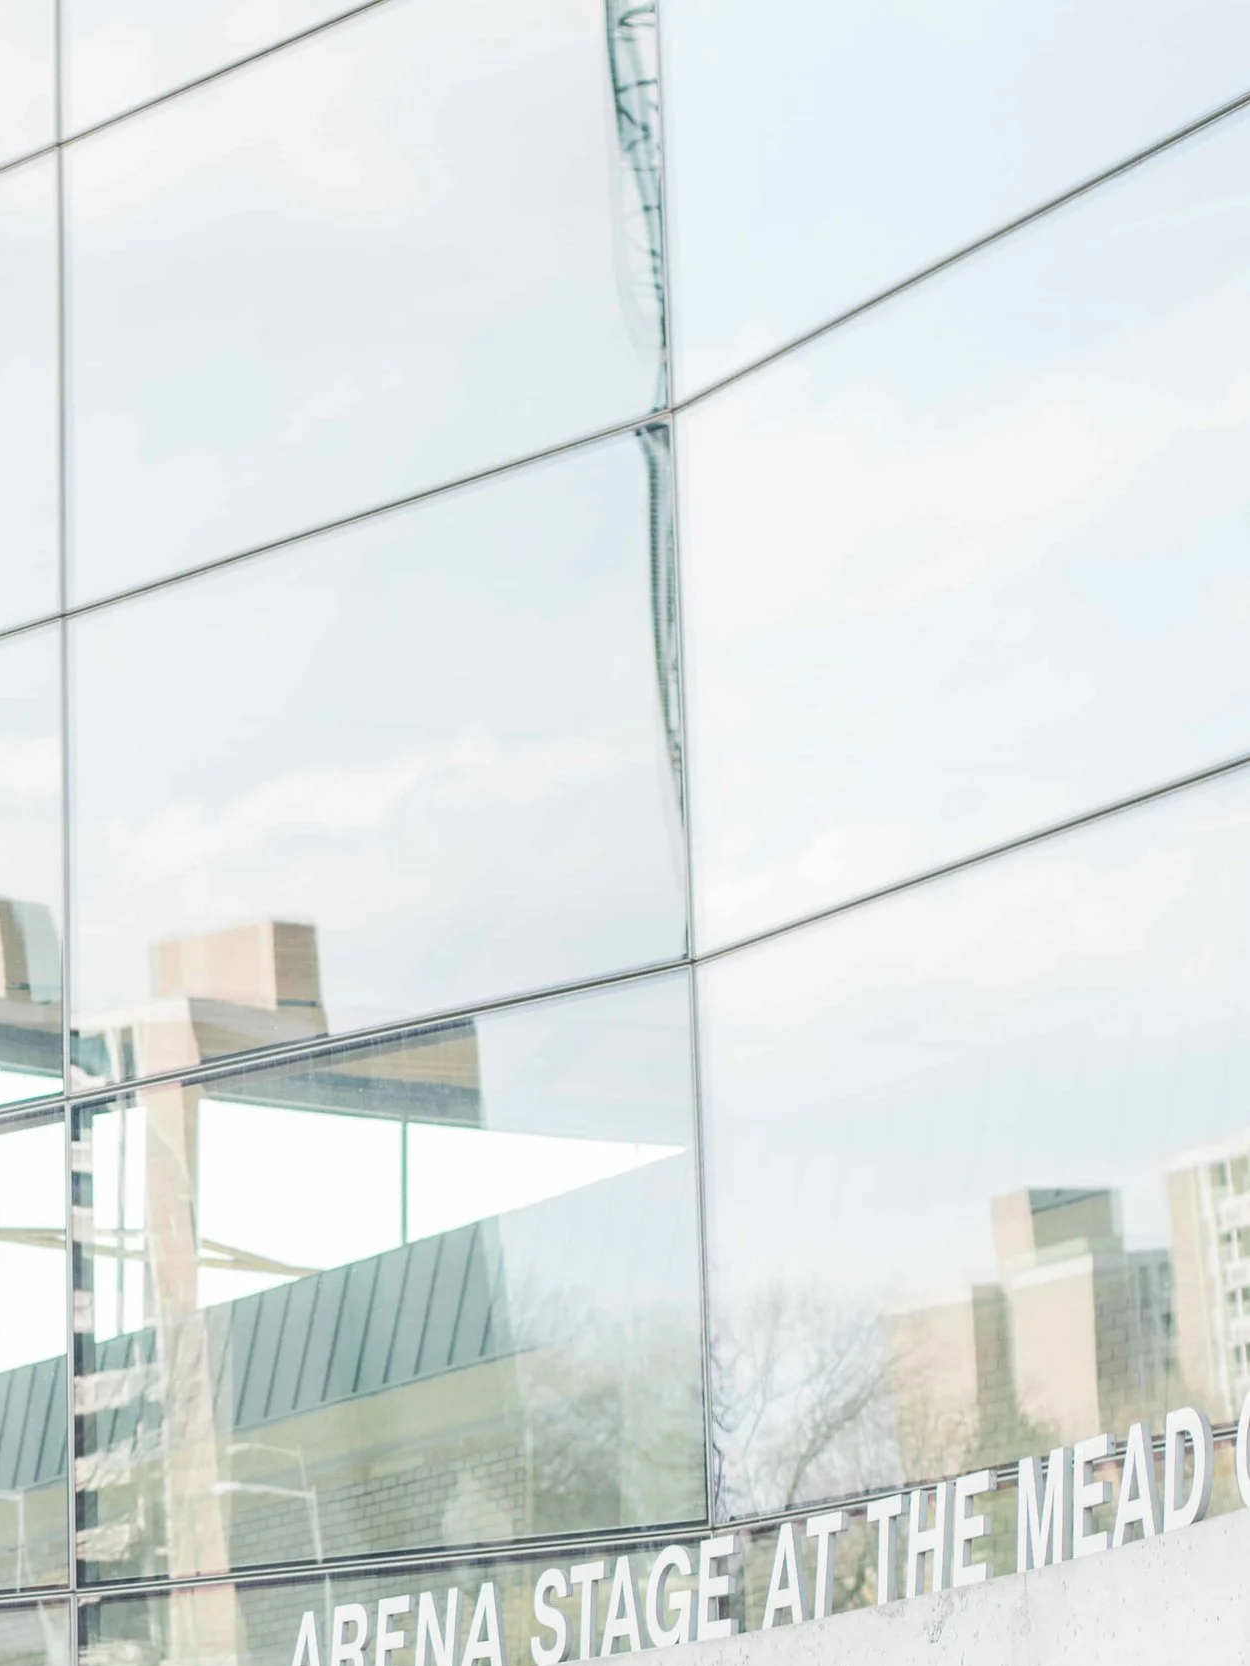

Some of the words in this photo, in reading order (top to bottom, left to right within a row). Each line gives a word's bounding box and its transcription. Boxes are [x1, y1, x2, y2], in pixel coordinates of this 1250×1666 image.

[530, 1535, 740, 1666] STAGE
[762, 1511, 847, 1630] AT
[867, 1469, 997, 1605] THE
[1016, 1406, 1214, 1575] MEAD
